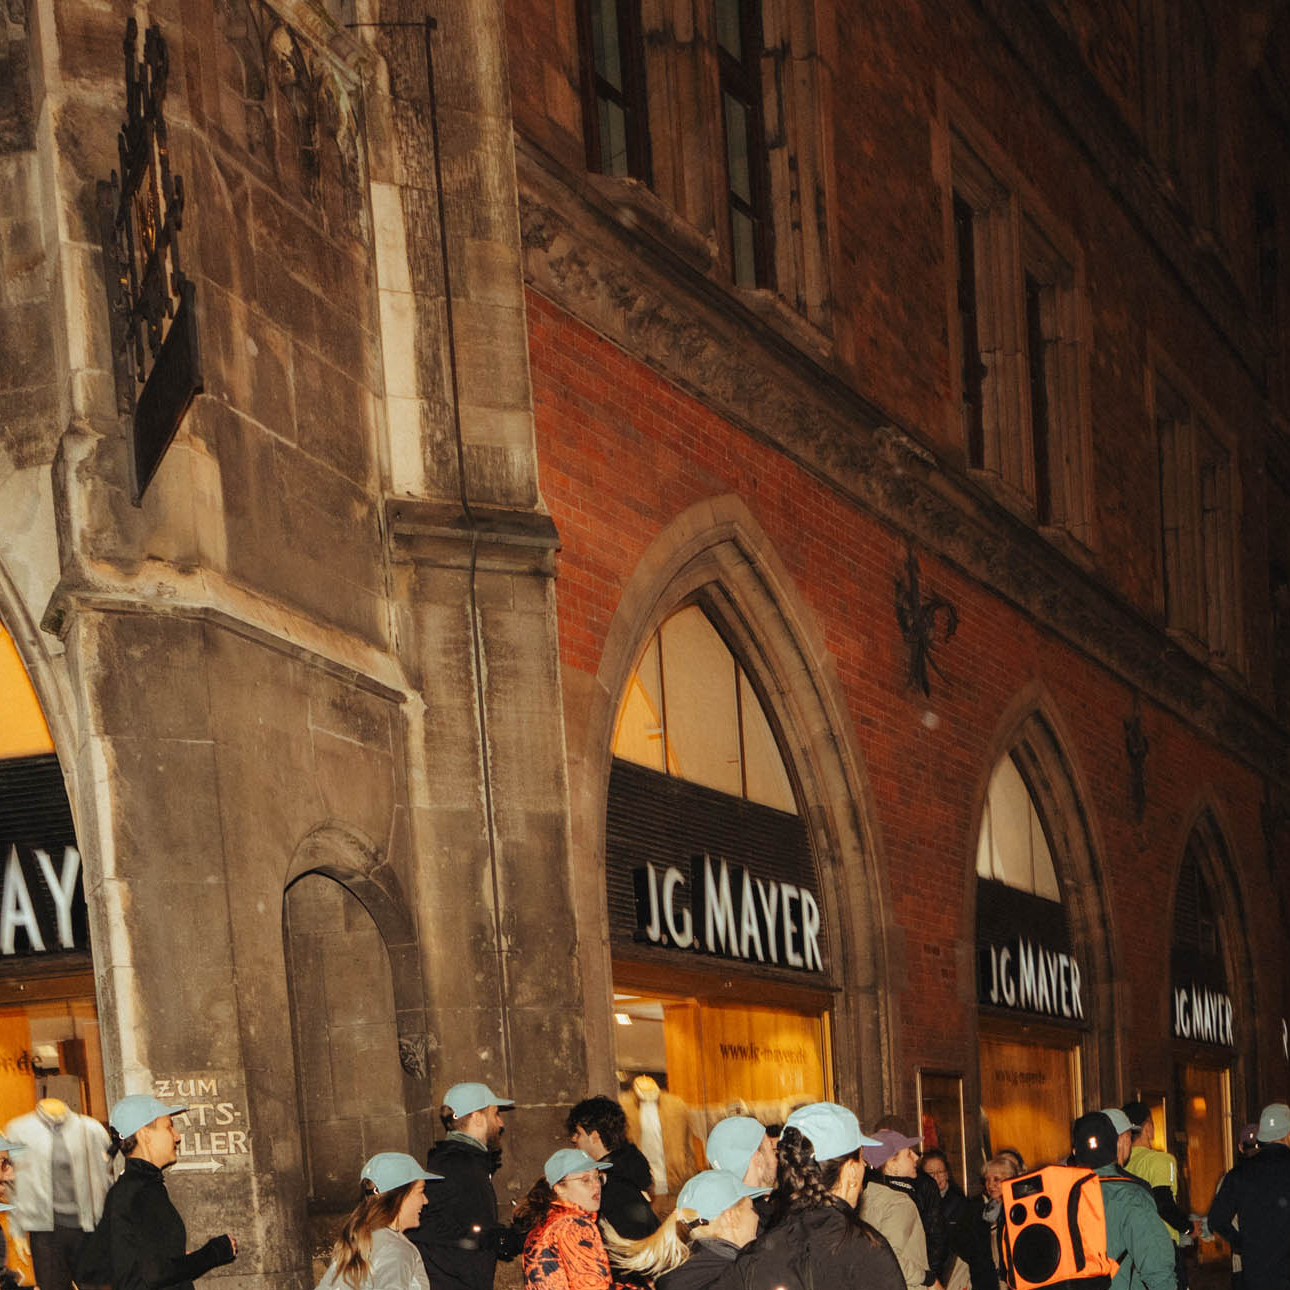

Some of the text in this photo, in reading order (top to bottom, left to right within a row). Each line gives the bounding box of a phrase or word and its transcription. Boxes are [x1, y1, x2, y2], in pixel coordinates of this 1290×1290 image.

[646, 852, 823, 972] J.G. MAYER
[1019, 934, 1085, 1020] MAYER
[1192, 983, 1234, 1047] MAYER
[155, 1079, 219, 1097] ZUM
[176, 1130, 249, 1156] LLER
